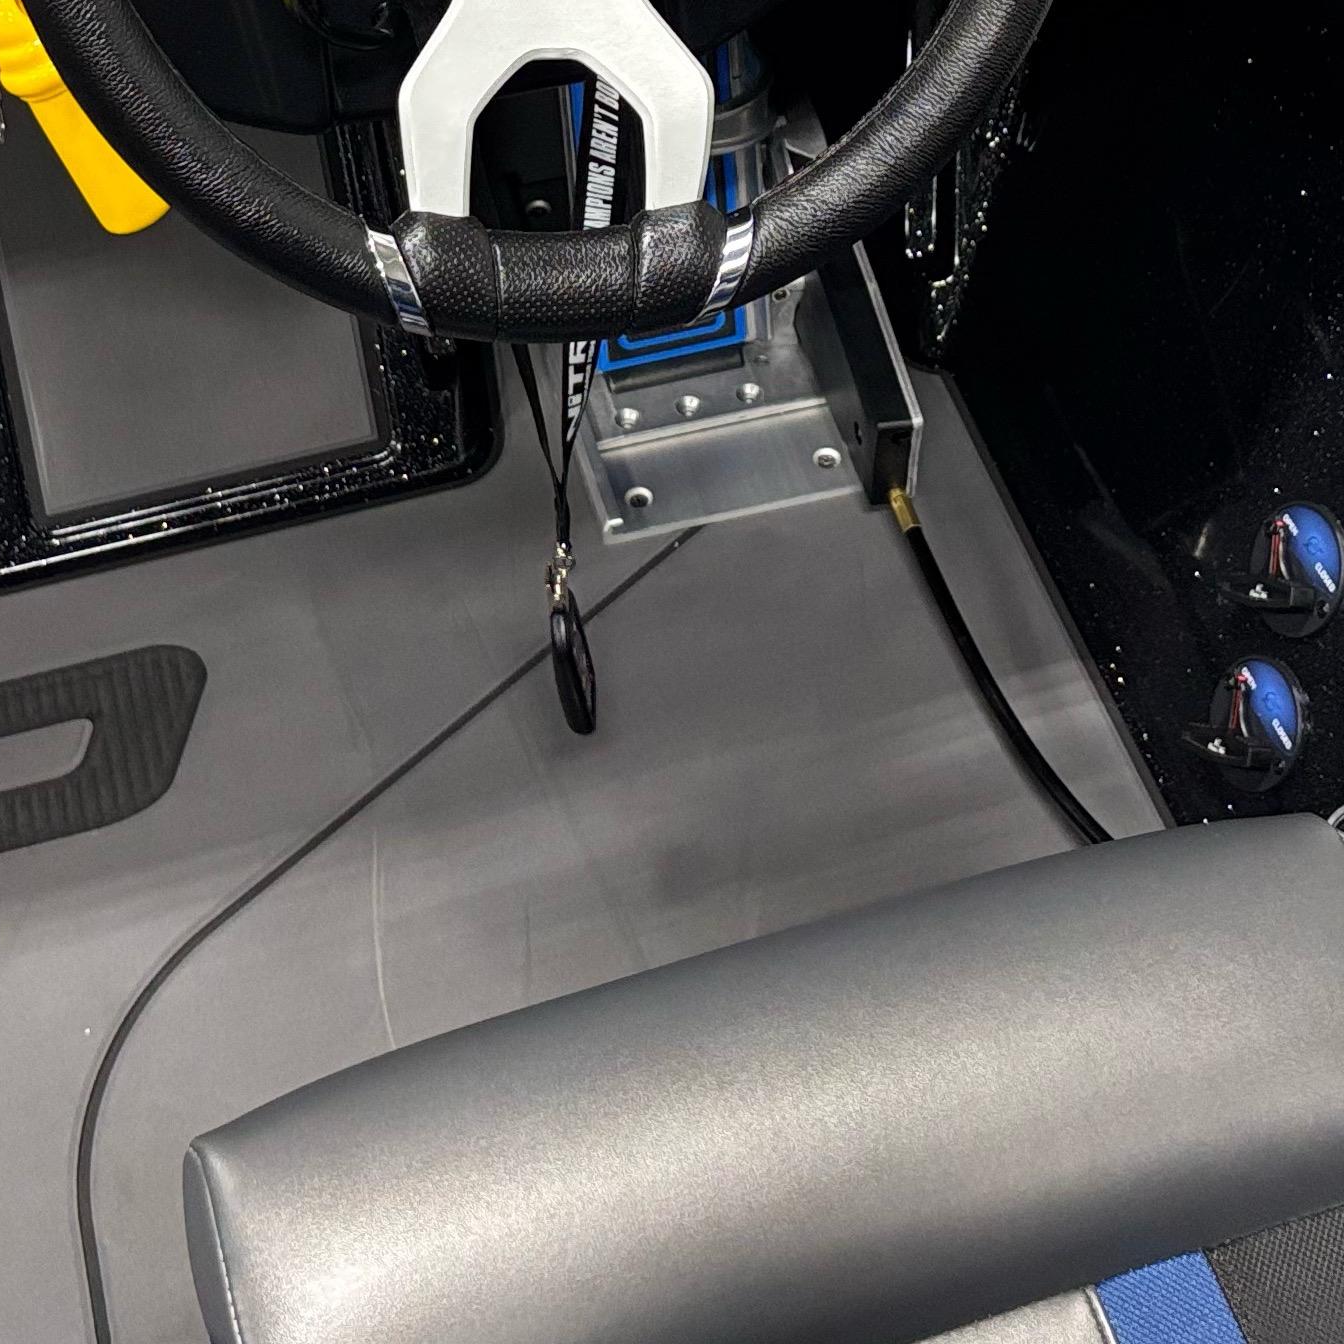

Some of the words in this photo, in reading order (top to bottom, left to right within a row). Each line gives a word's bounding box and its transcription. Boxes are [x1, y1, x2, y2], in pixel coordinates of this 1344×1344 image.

[589, 104, 619, 165] AREN'T
[583, 160, 616, 231] AMPIONS
[1282, 513, 1299, 537] OPEN
[1315, 561, 1337, 593] CLOSED
